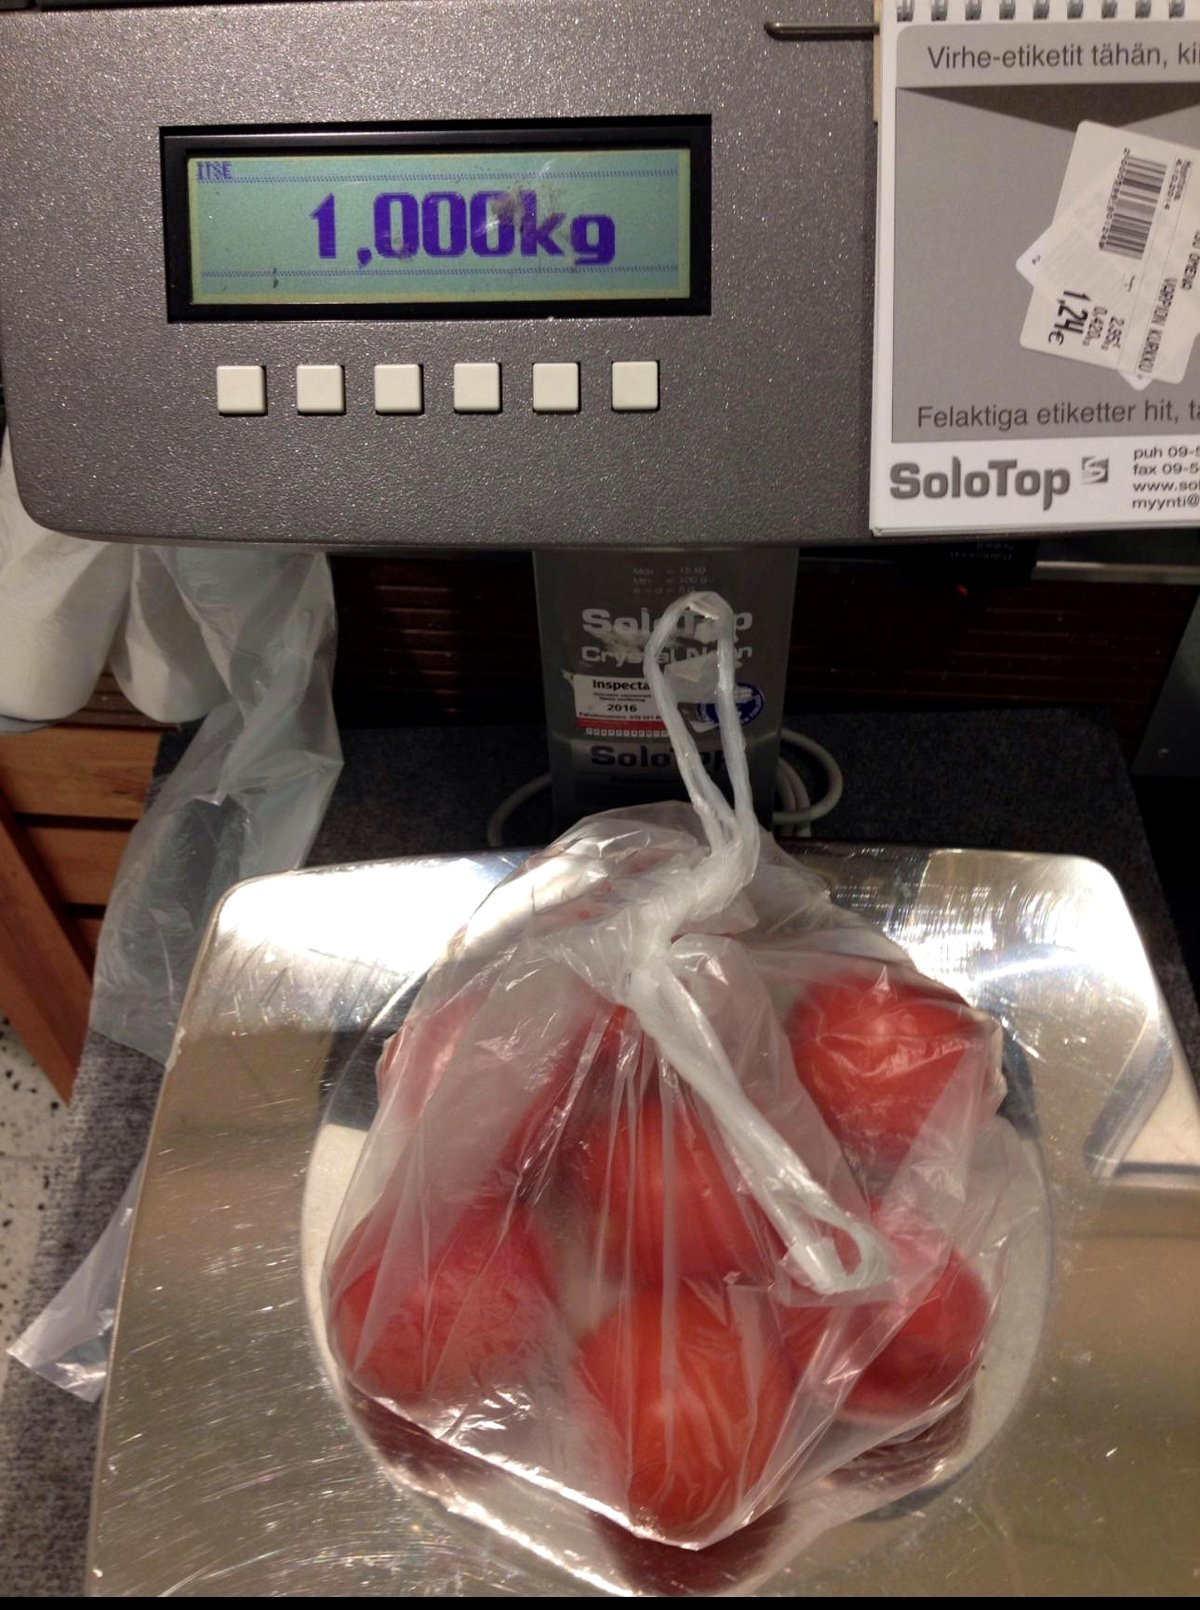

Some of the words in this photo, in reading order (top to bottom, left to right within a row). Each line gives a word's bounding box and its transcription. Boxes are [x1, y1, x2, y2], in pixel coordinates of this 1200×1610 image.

[928, 43, 1083, 69] Virhe-etiketit
[1091, 42, 1168, 69] tähän,
[310, 189, 616, 269] 1,000kg
[917, 404, 1028, 431] Felaktiga
[1037, 402, 1136, 425] etiketter
[1144, 399, 1180, 425] hit,
[1188, 400, 1200, 422] t
[1133, 446, 1163, 461] puh
[1133, 463, 1157, 476] fax
[889, 456, 1071, 511] SoloTop
[607, 703, 637, 713] 2016
